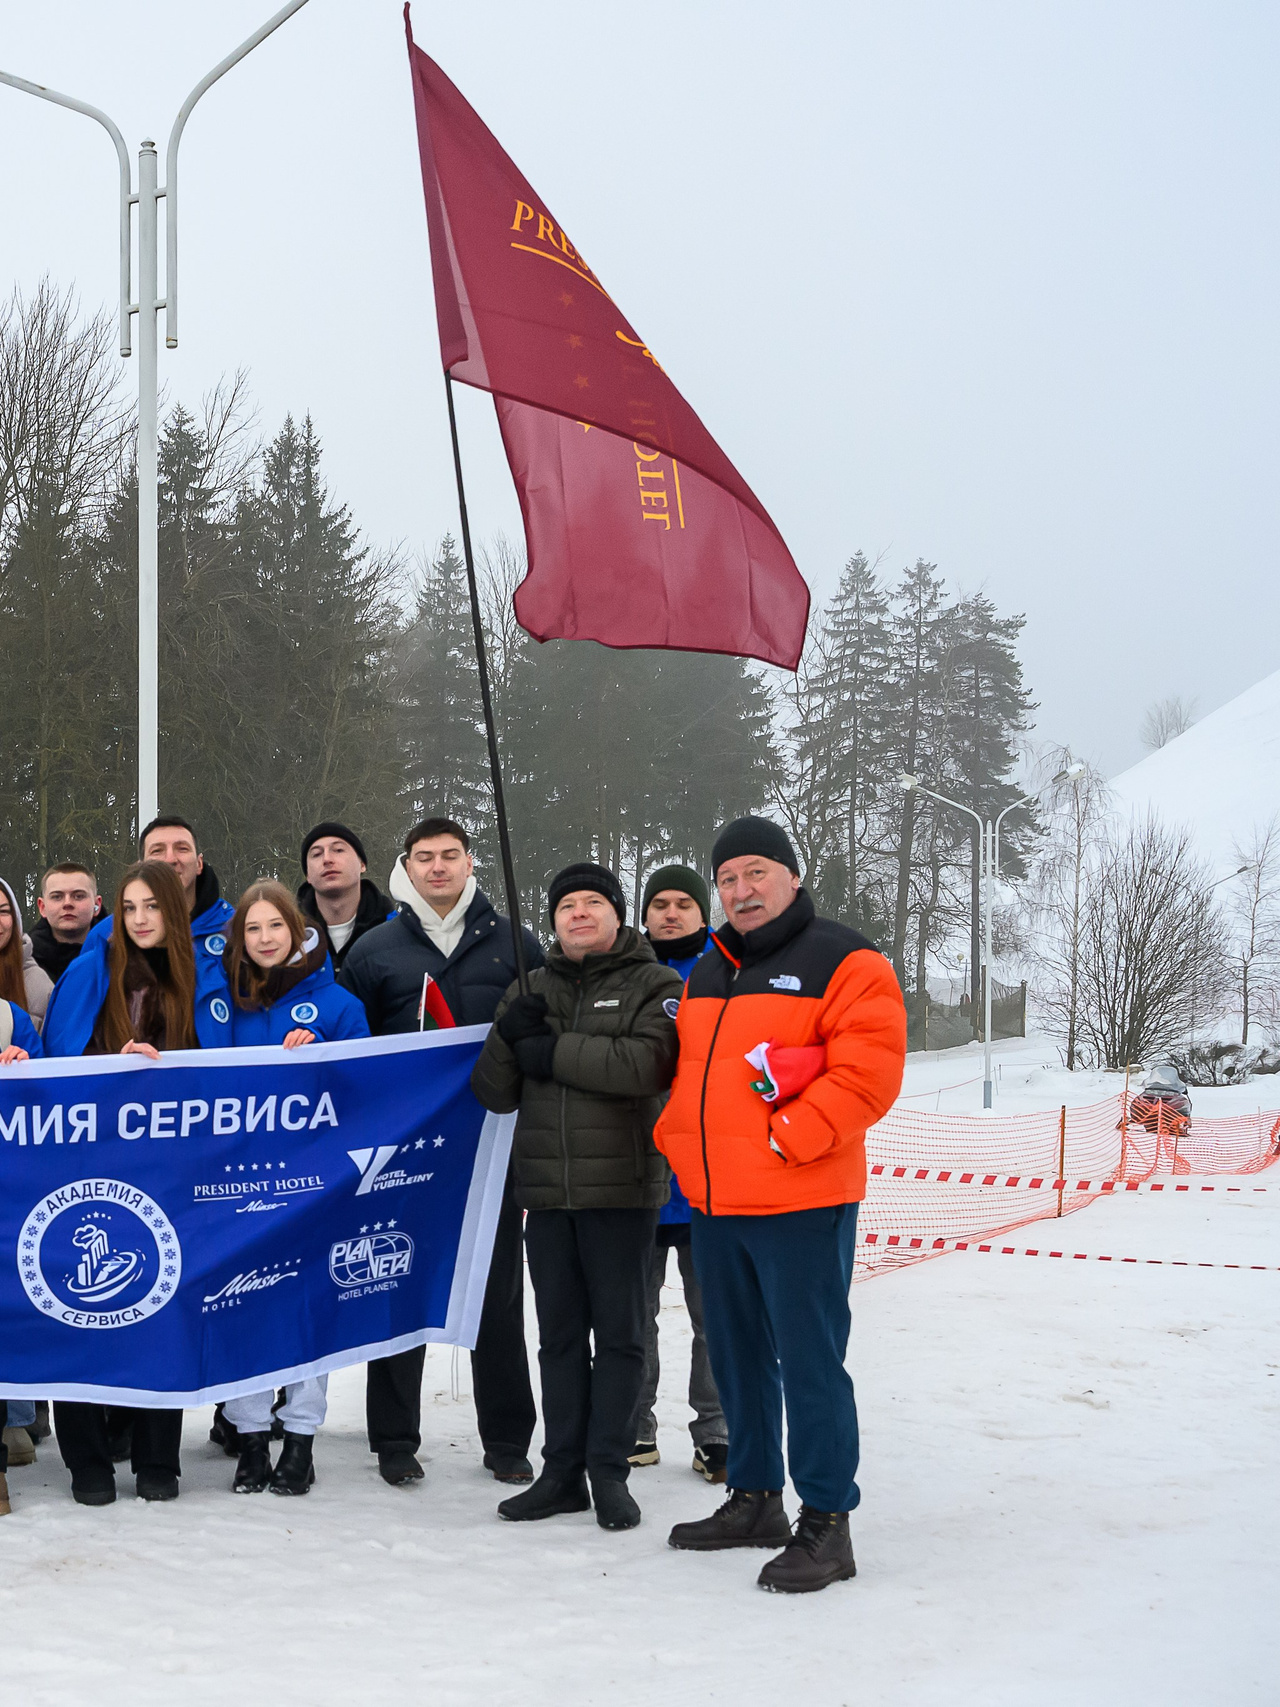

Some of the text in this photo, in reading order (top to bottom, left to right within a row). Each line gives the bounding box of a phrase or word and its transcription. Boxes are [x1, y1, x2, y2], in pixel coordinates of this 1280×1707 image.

[117, 1091, 339, 1140] СЕРВИСА
[194, 1175, 324, 1196] PRESIDENT HOTEL
[373, 1172, 434, 1191] YUBILEINY
[374, 1169, 407, 1182] HOTEL
[46, 1182, 144, 1214] АКАДЕМИЯ
[337, 1280, 399, 1302] HOTEL PLANETA
[201, 1298, 242, 1313] HOTEL
[61, 1307, 145, 1326] СЕРВИСА
